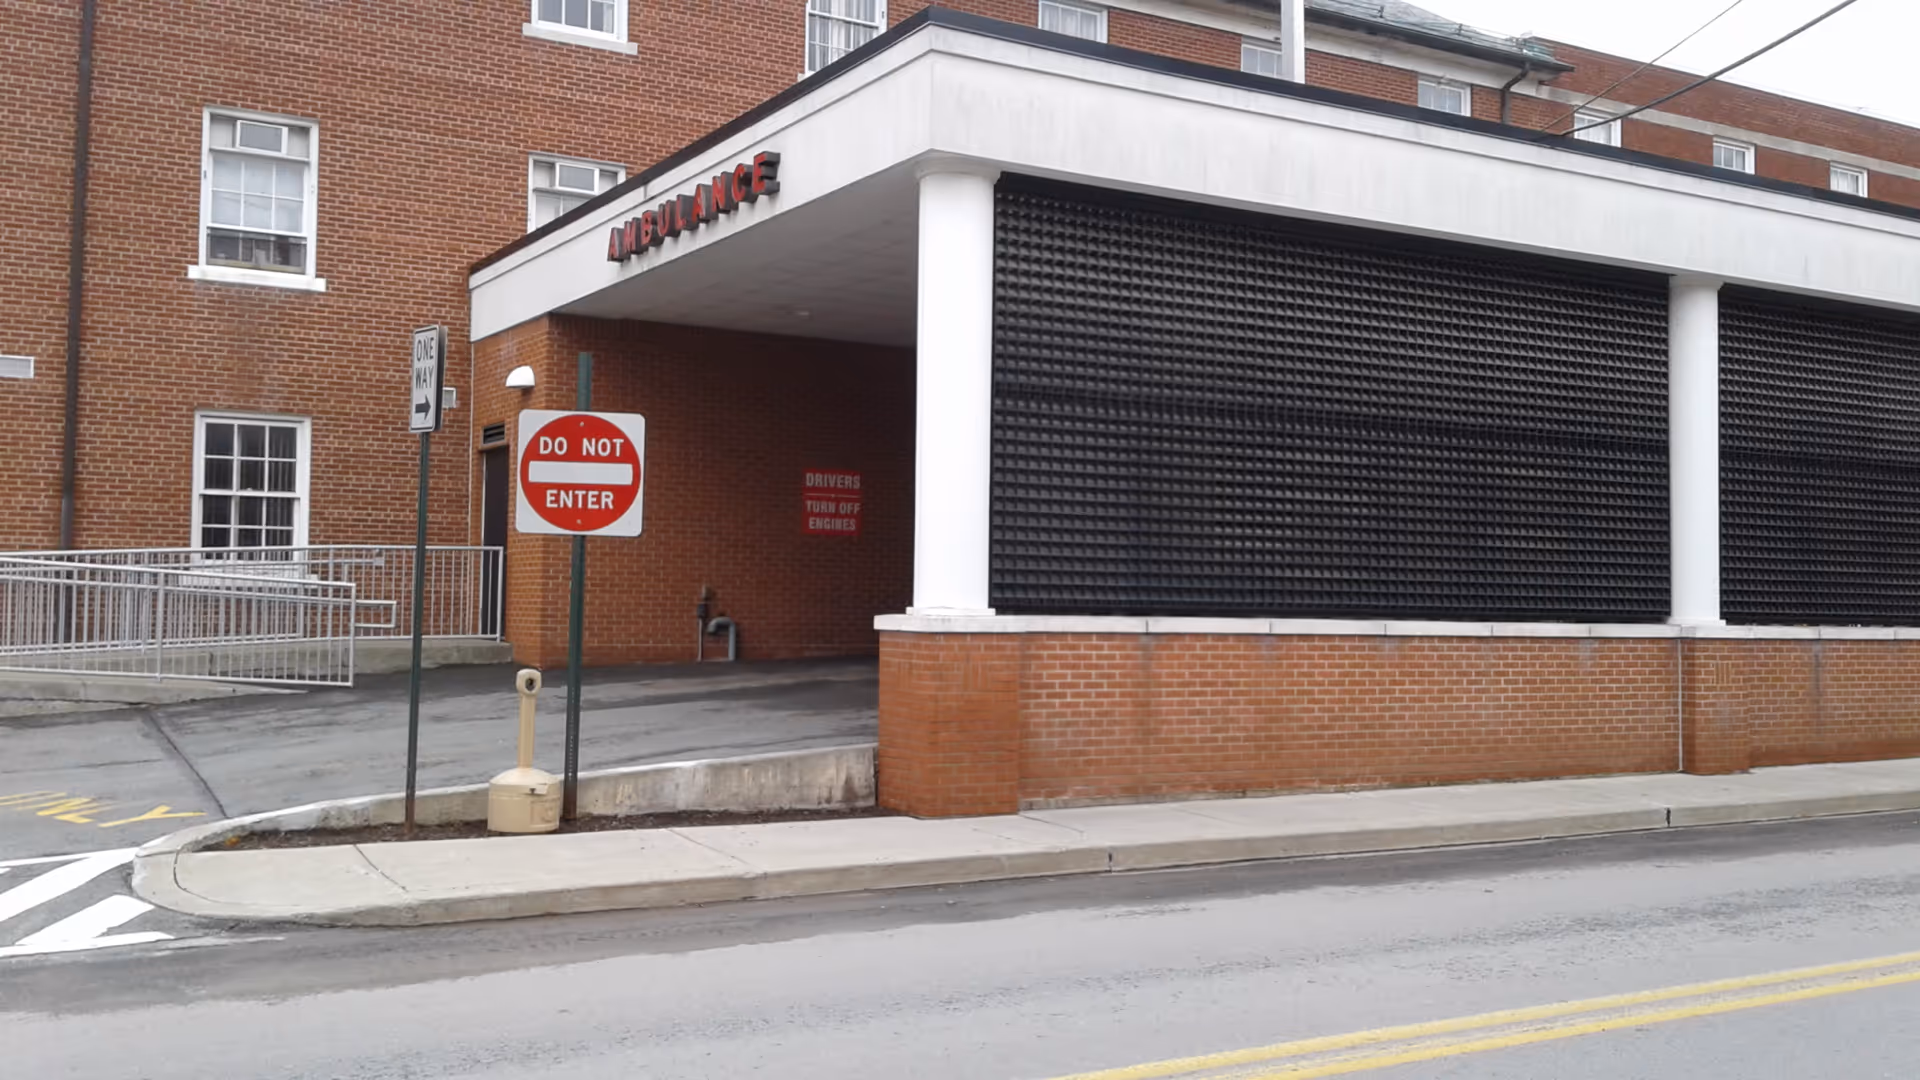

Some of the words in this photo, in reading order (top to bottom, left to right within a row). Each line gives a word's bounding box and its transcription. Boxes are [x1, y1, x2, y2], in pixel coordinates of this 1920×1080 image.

[607, 151, 781, 263] AMBULANCE
[416, 336, 435, 362] ONE
[415, 365, 434, 390] WAY
[539, 436, 568, 455] DO
[582, 437, 624, 457] NOT
[806, 473, 861, 489] DRIVERS
[545, 489, 614, 510] ENTER
[806, 500, 836, 513] TURN
[839, 502, 861, 514] OFF
[808, 517, 856, 531] ENGINES
